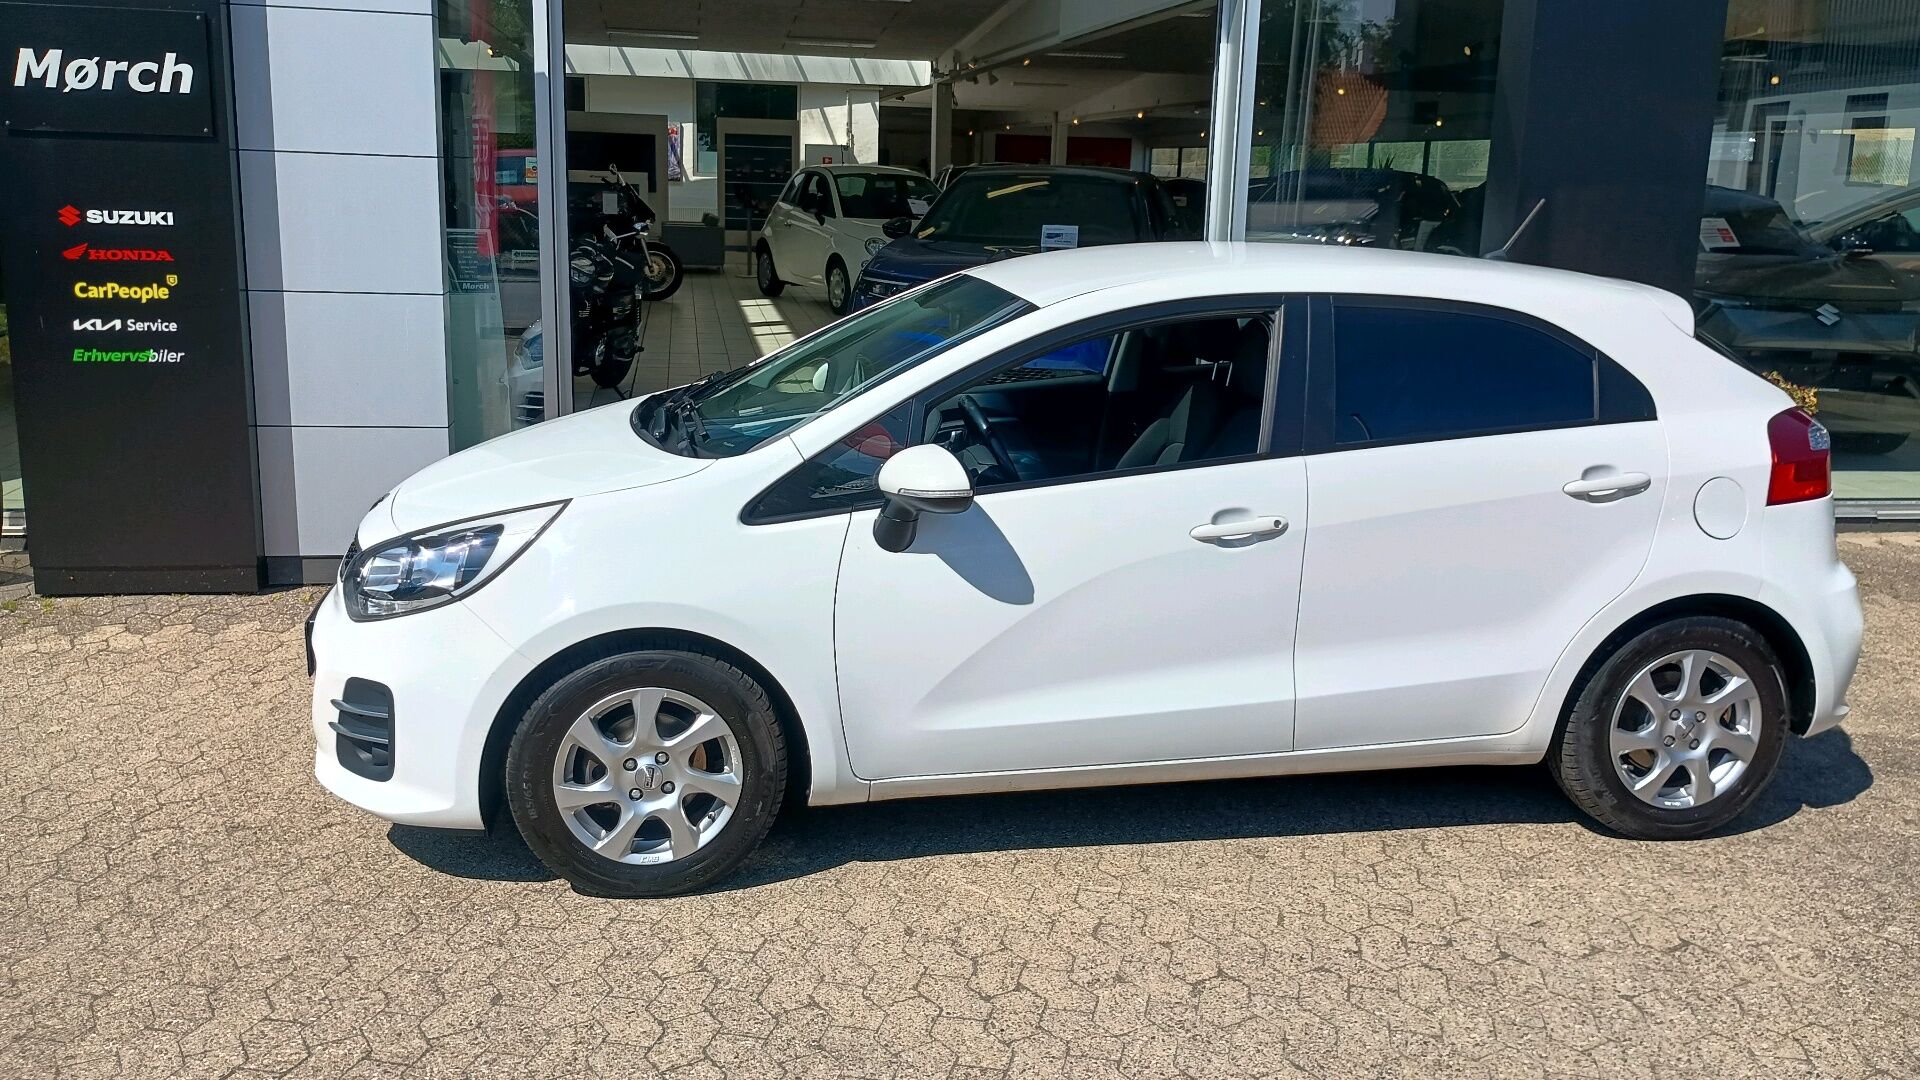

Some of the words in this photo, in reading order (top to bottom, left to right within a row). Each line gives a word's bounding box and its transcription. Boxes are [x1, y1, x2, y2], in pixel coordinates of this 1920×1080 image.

[14, 48, 194, 94] Mørch
[86, 210, 174, 226] SUZUKI
[87, 249, 175, 262] HONDA
[74, 282, 170, 304] CarPeople
[127, 319, 178, 332] Service
[73, 349, 185, 363] Erhvervsbiler
